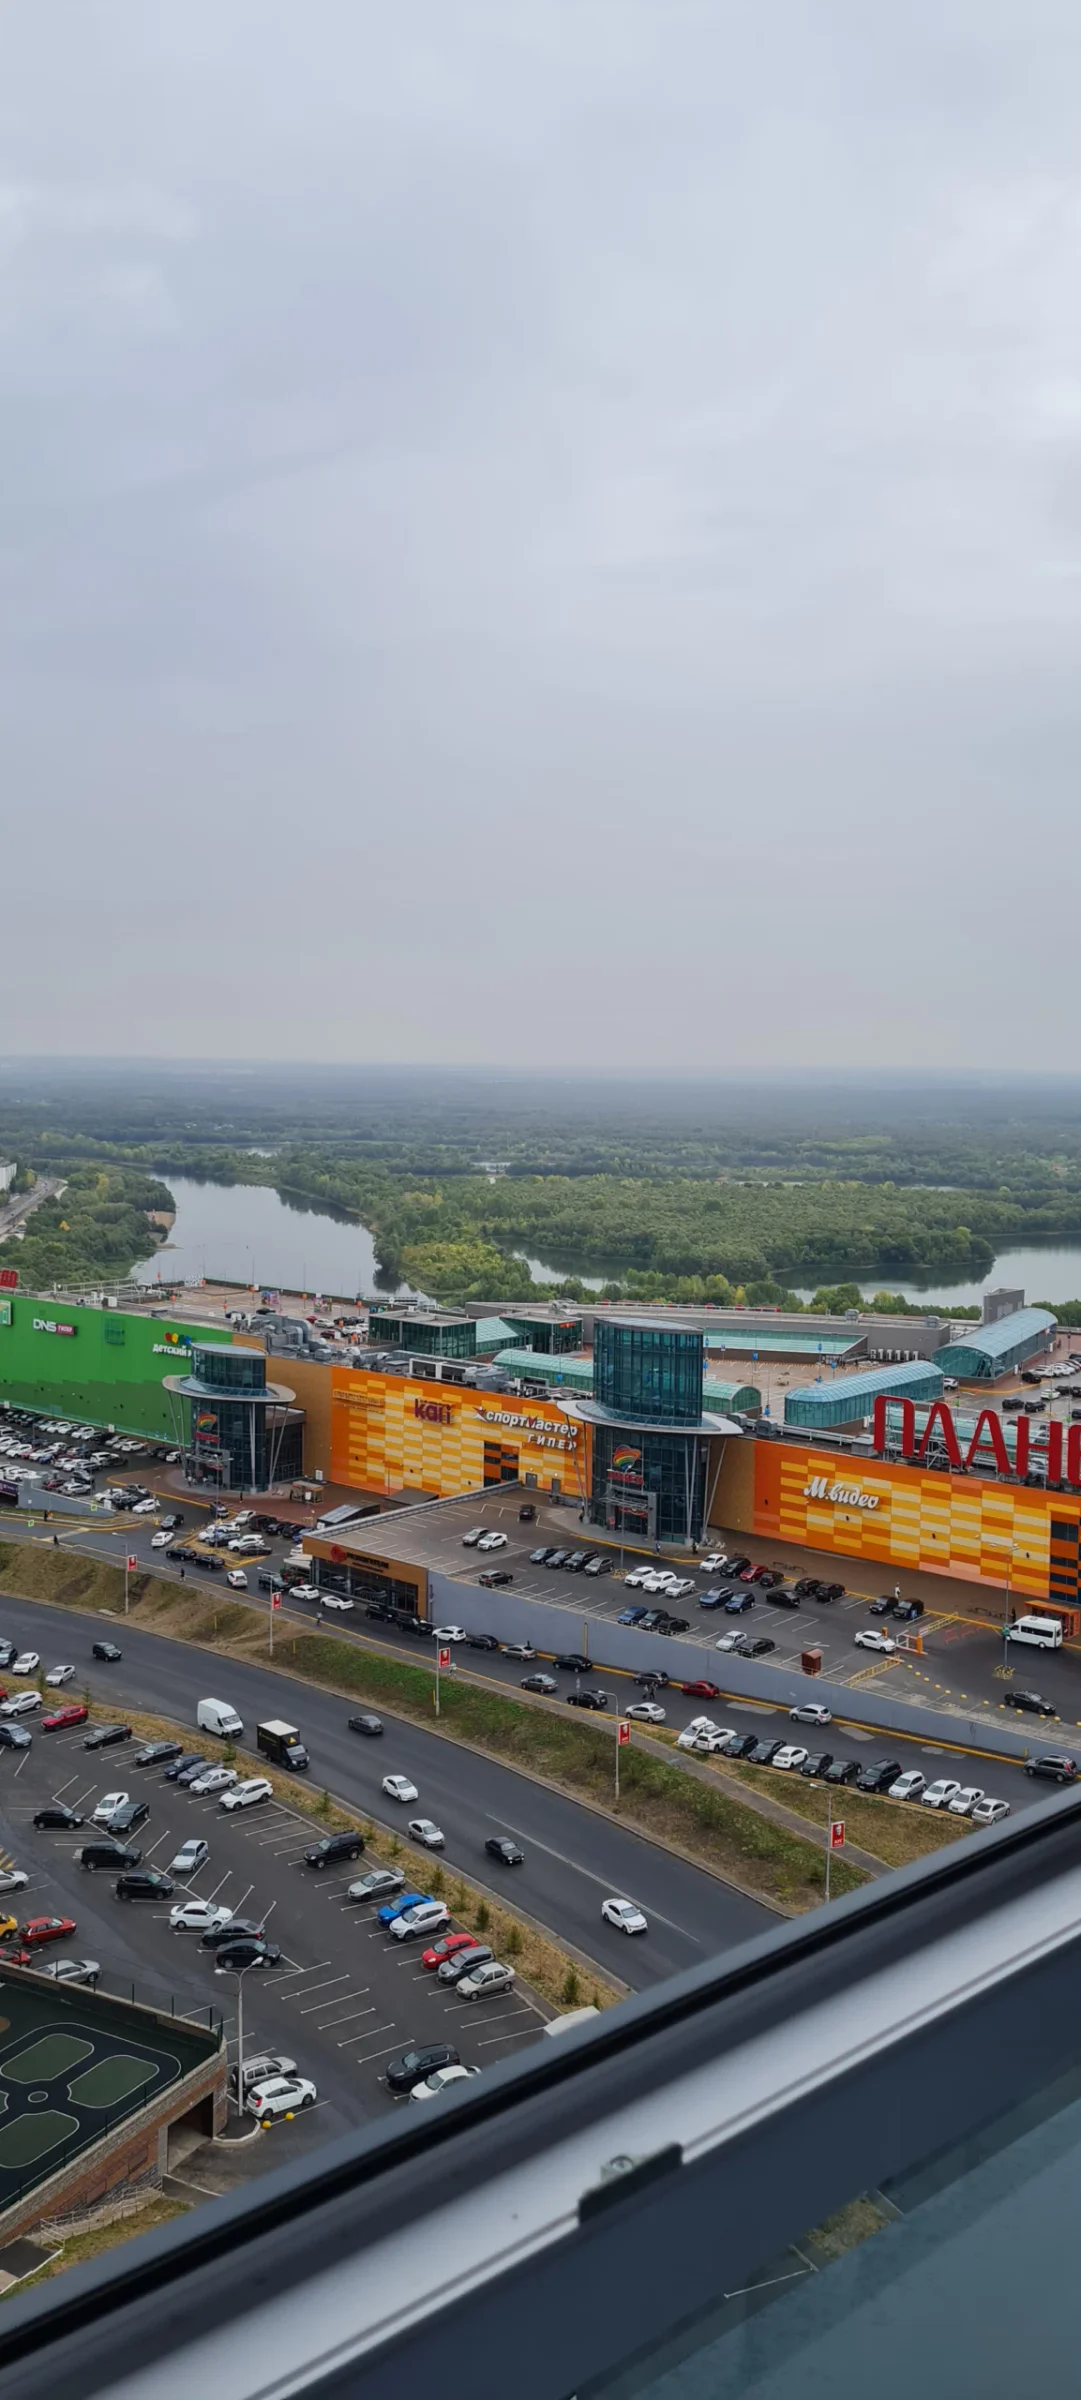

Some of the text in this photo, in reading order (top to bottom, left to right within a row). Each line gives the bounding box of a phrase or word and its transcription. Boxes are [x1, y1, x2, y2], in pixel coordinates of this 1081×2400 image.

[33, 1318, 57, 1333] DNS
[414, 1398, 453, 1425] kari
[803, 1475, 879, 1510] М.видео
